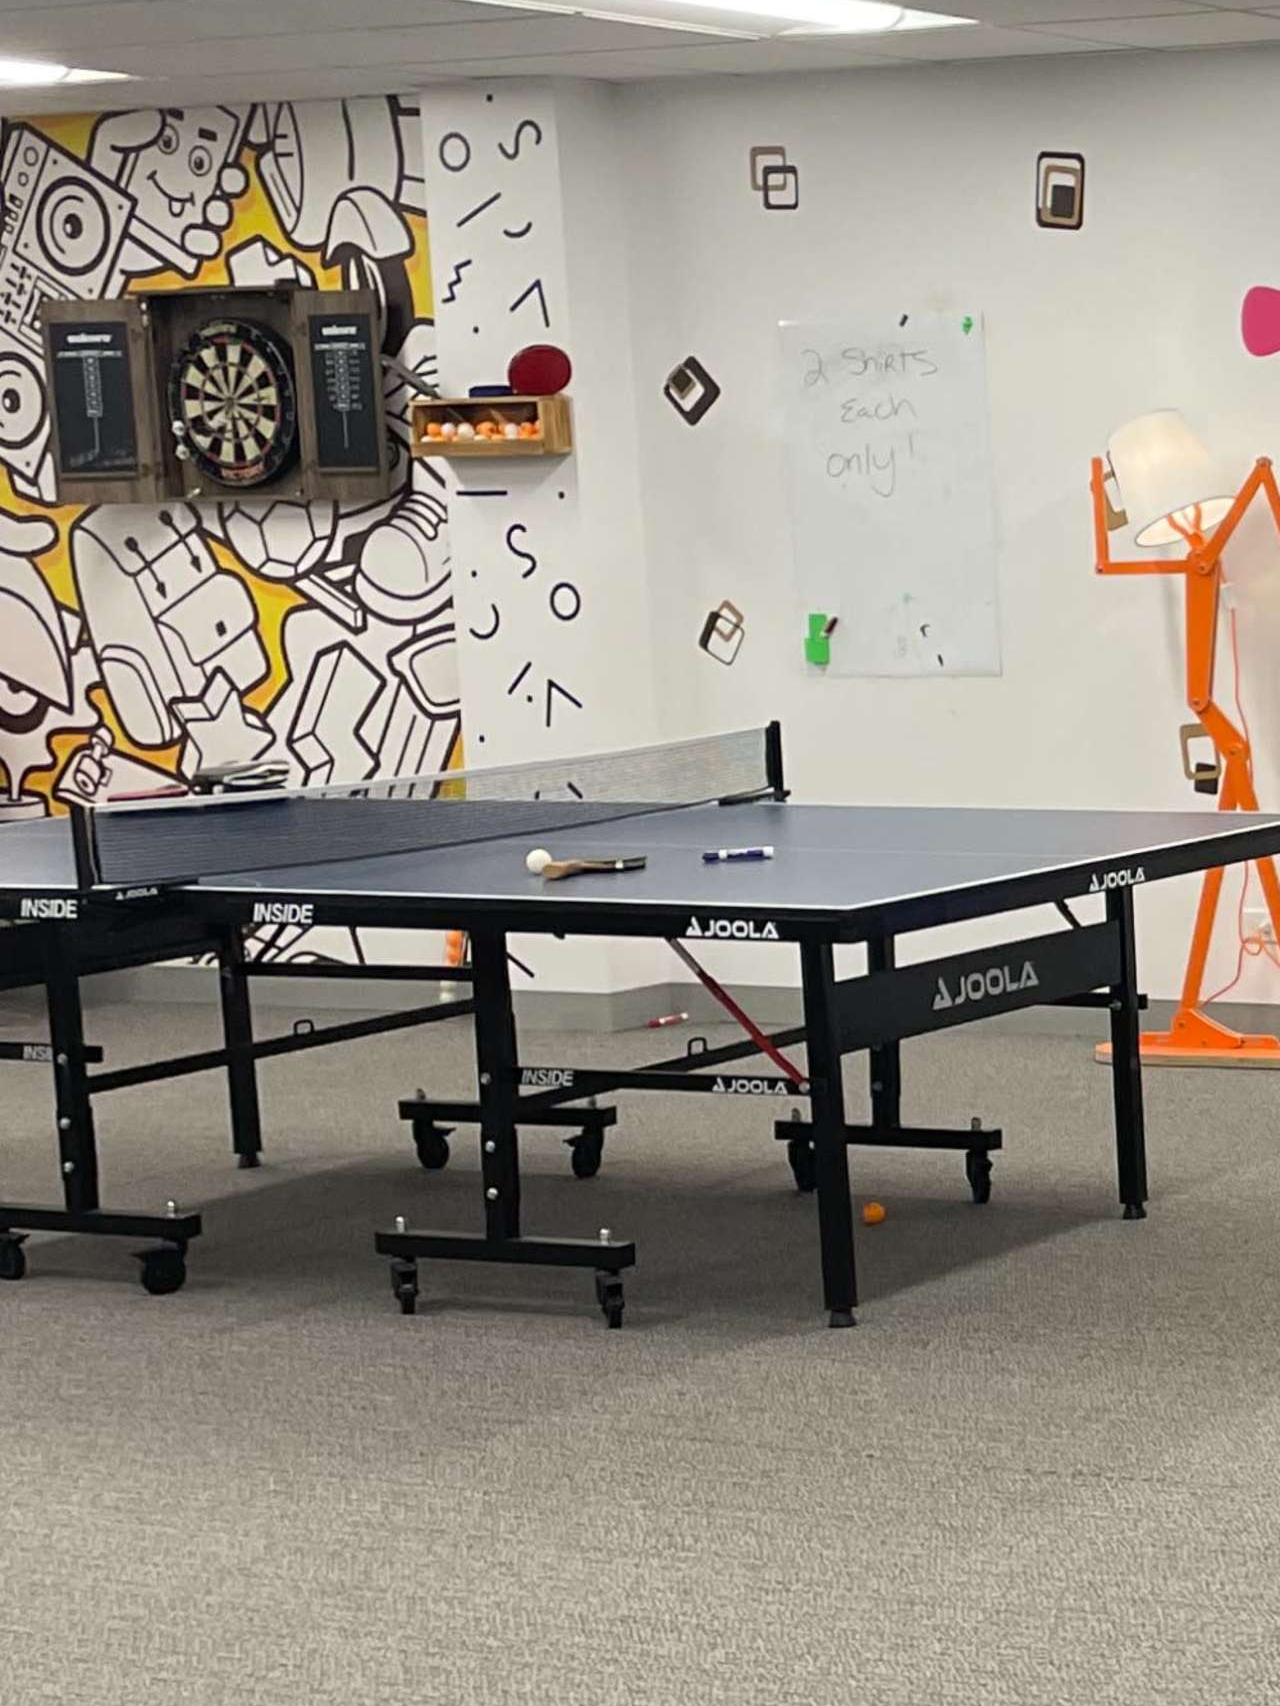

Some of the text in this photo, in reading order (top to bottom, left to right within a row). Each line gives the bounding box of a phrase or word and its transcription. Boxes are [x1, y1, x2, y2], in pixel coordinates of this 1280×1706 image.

[800, 348, 830, 388] 2
[1100, 866, 1146, 890] JOOLA
[20, 898, 78, 919] INSIDE
[252, 902, 315, 924] INSIDE
[703, 918, 780, 940] JOOLA
[954, 961, 1039, 1005] JOOLA
[521, 1069, 575, 1087] INSIDE
[727, 1078, 789, 1095] JOOLA
